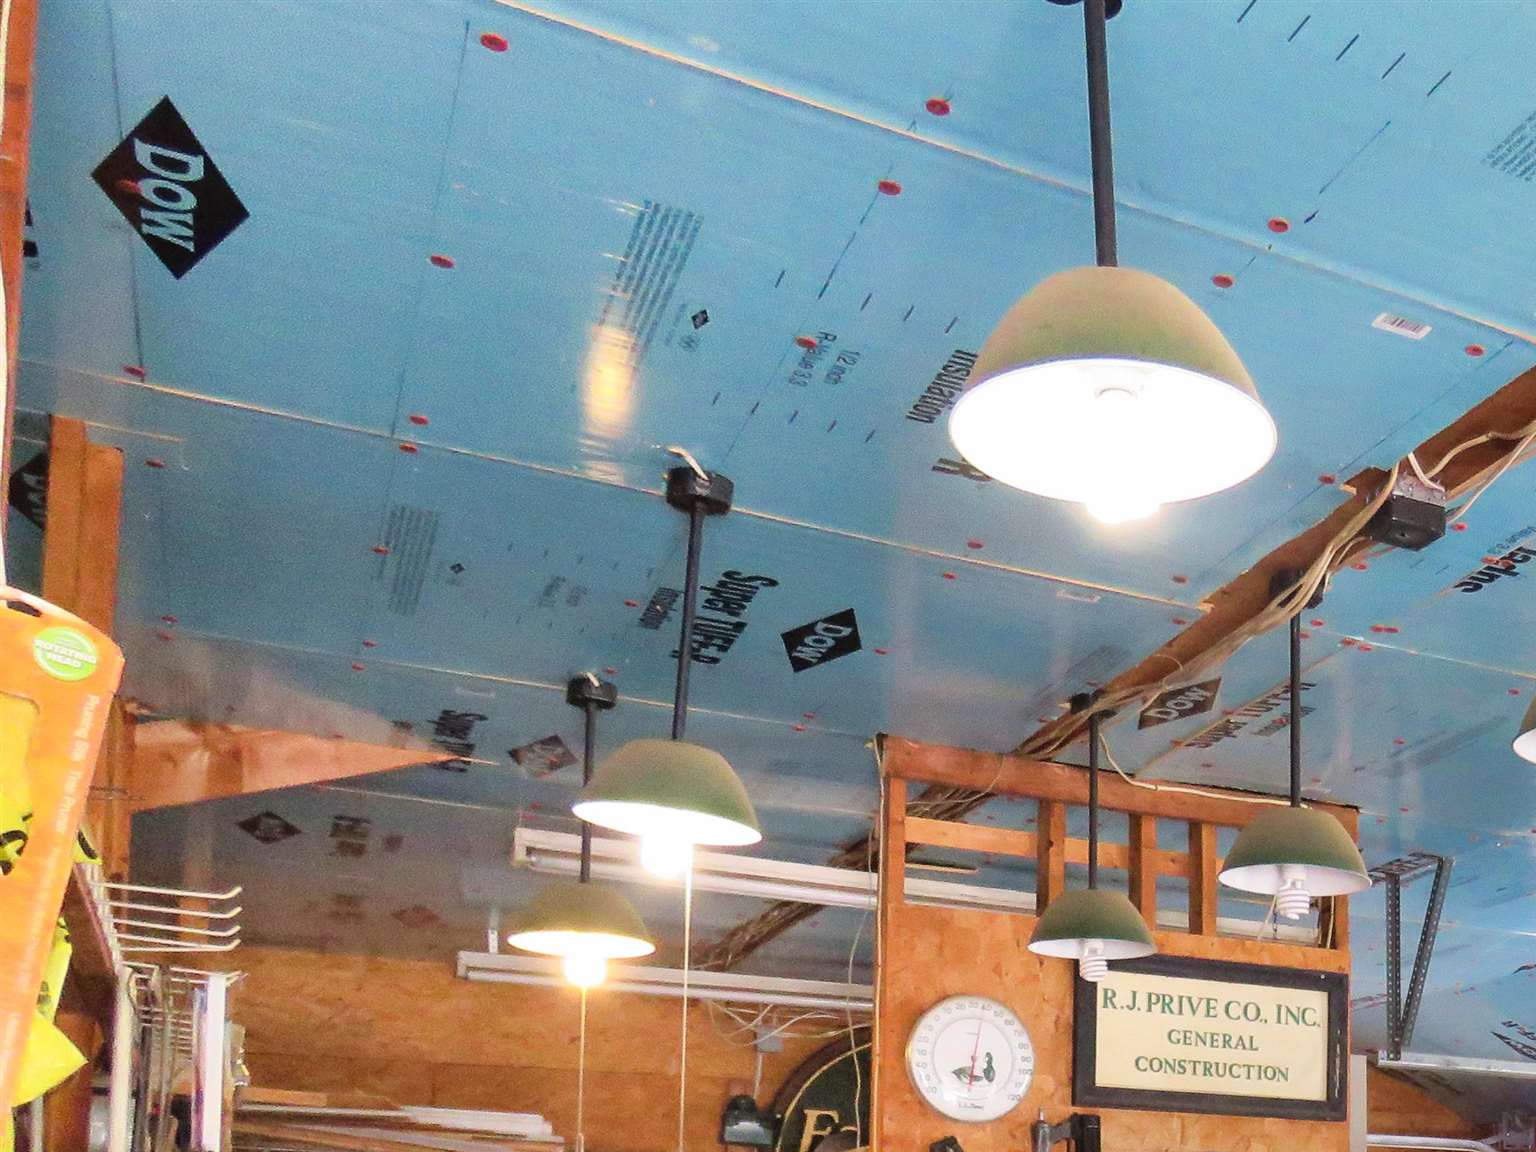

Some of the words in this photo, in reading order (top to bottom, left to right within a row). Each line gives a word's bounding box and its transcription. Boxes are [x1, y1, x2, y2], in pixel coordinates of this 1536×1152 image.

[132, 136, 205, 253] DOW
[905, 348, 979, 424] Insulation
[791, 621, 853, 664] DOW
[1145, 686, 1211, 720] DOW
[1146, 991, 1219, 1019] PRIVE
[1275, 1003, 1322, 1029] INC.
[1166, 1028, 1260, 1052] GENERAL
[1134, 1055, 1290, 1083] CONSTRUCTION
